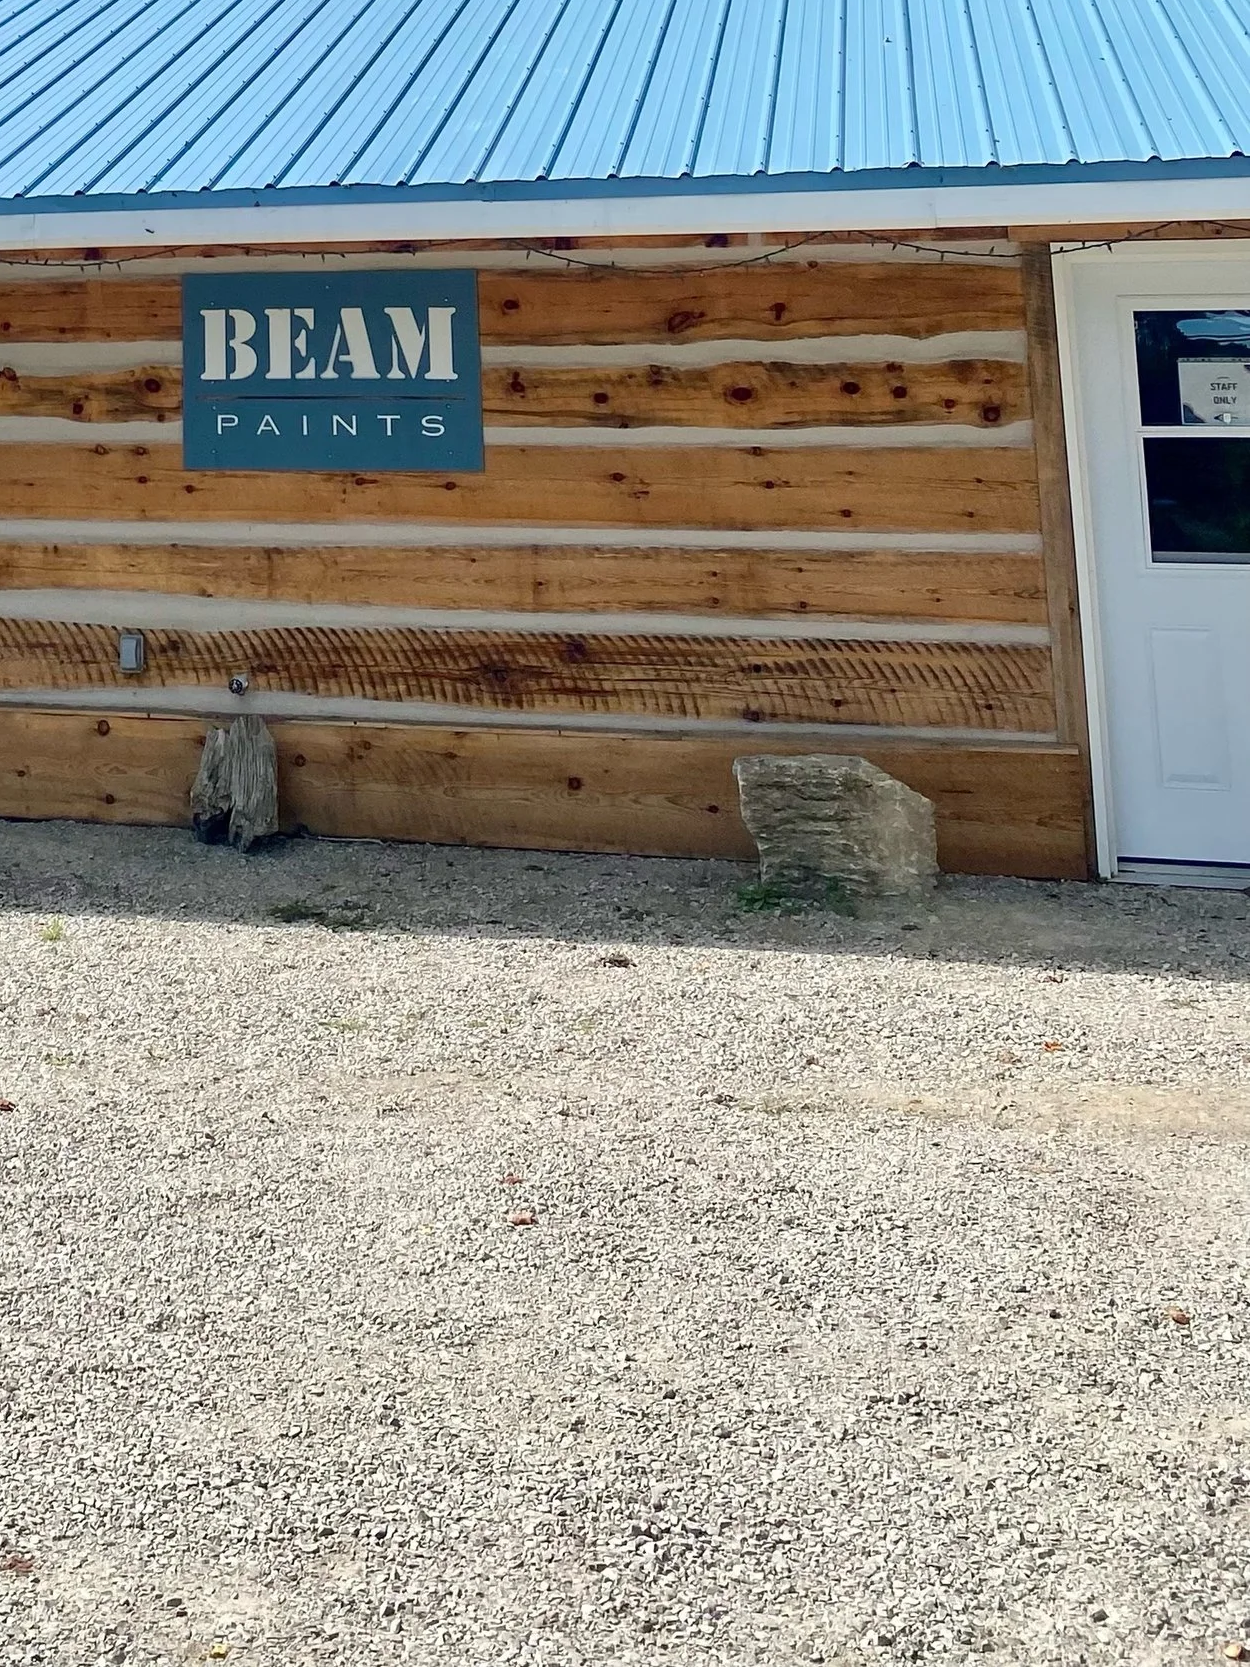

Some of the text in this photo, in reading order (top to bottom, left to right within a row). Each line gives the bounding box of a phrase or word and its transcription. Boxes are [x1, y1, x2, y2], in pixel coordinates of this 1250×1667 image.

[200, 306, 459, 380] BEAM
[1210, 383, 1238, 391] STAFF
[1213, 396, 1237, 404] ONLY
[216, 414, 446, 437] PAINTS
